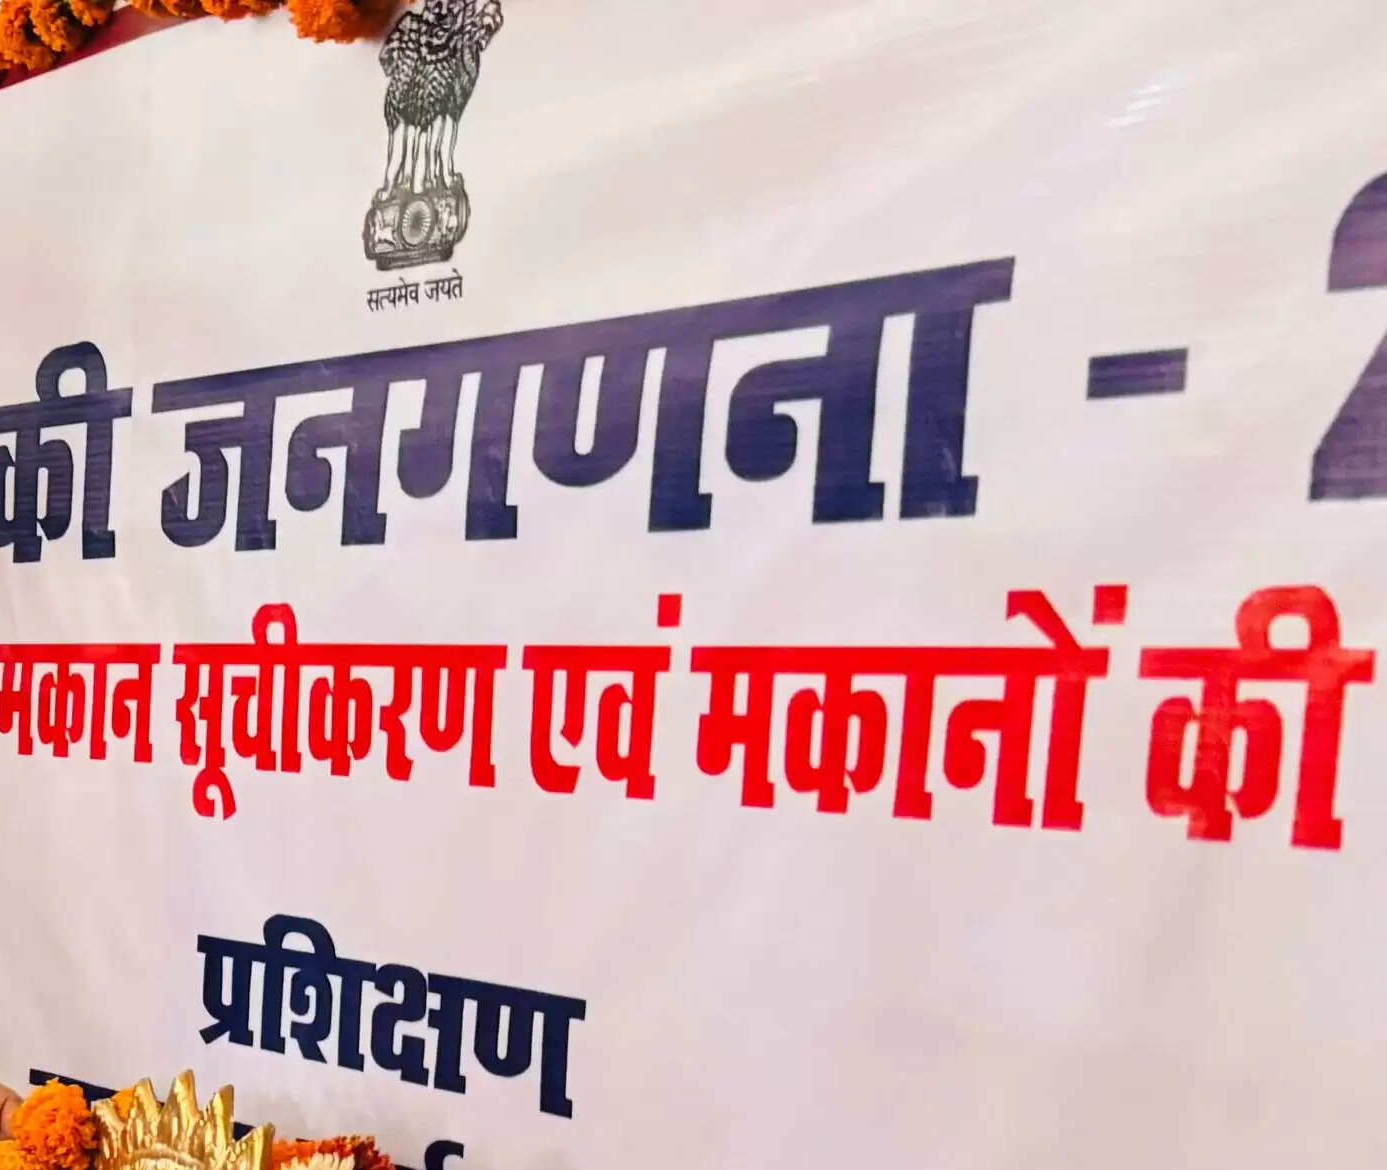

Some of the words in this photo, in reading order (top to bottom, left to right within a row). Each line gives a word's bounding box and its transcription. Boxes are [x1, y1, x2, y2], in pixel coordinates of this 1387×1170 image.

[152, 256, 1016, 553] जनगणना
[366, 276, 420, 313] सत्यमेव
[424, 267, 464, 302] जयते
[173, 602, 509, 822] सूचीकरण
[522, 592, 683, 801] एवं
[690, 585, 1130, 833] मकानों
[1137, 584, 1378, 852] की
[197, 913, 588, 1120] प्रशिक्षण
